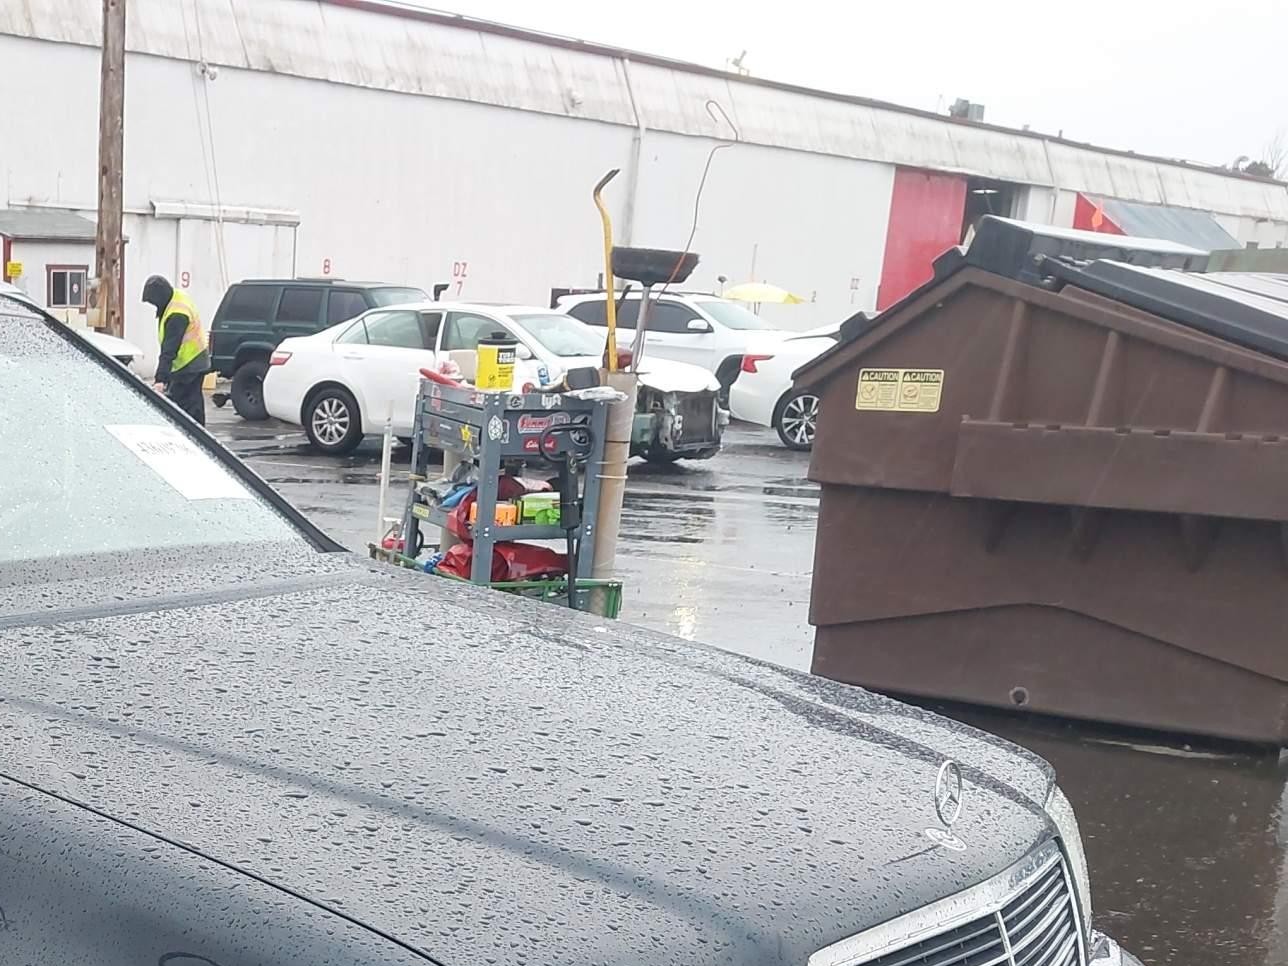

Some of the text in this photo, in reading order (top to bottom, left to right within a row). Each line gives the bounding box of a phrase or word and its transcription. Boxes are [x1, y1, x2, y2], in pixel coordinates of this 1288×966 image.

[323, 258, 331, 274] 8
[181, 271, 190, 288] 9
[869, 371, 899, 381] CAUTION
[911, 372, 942, 382] CAUTION
